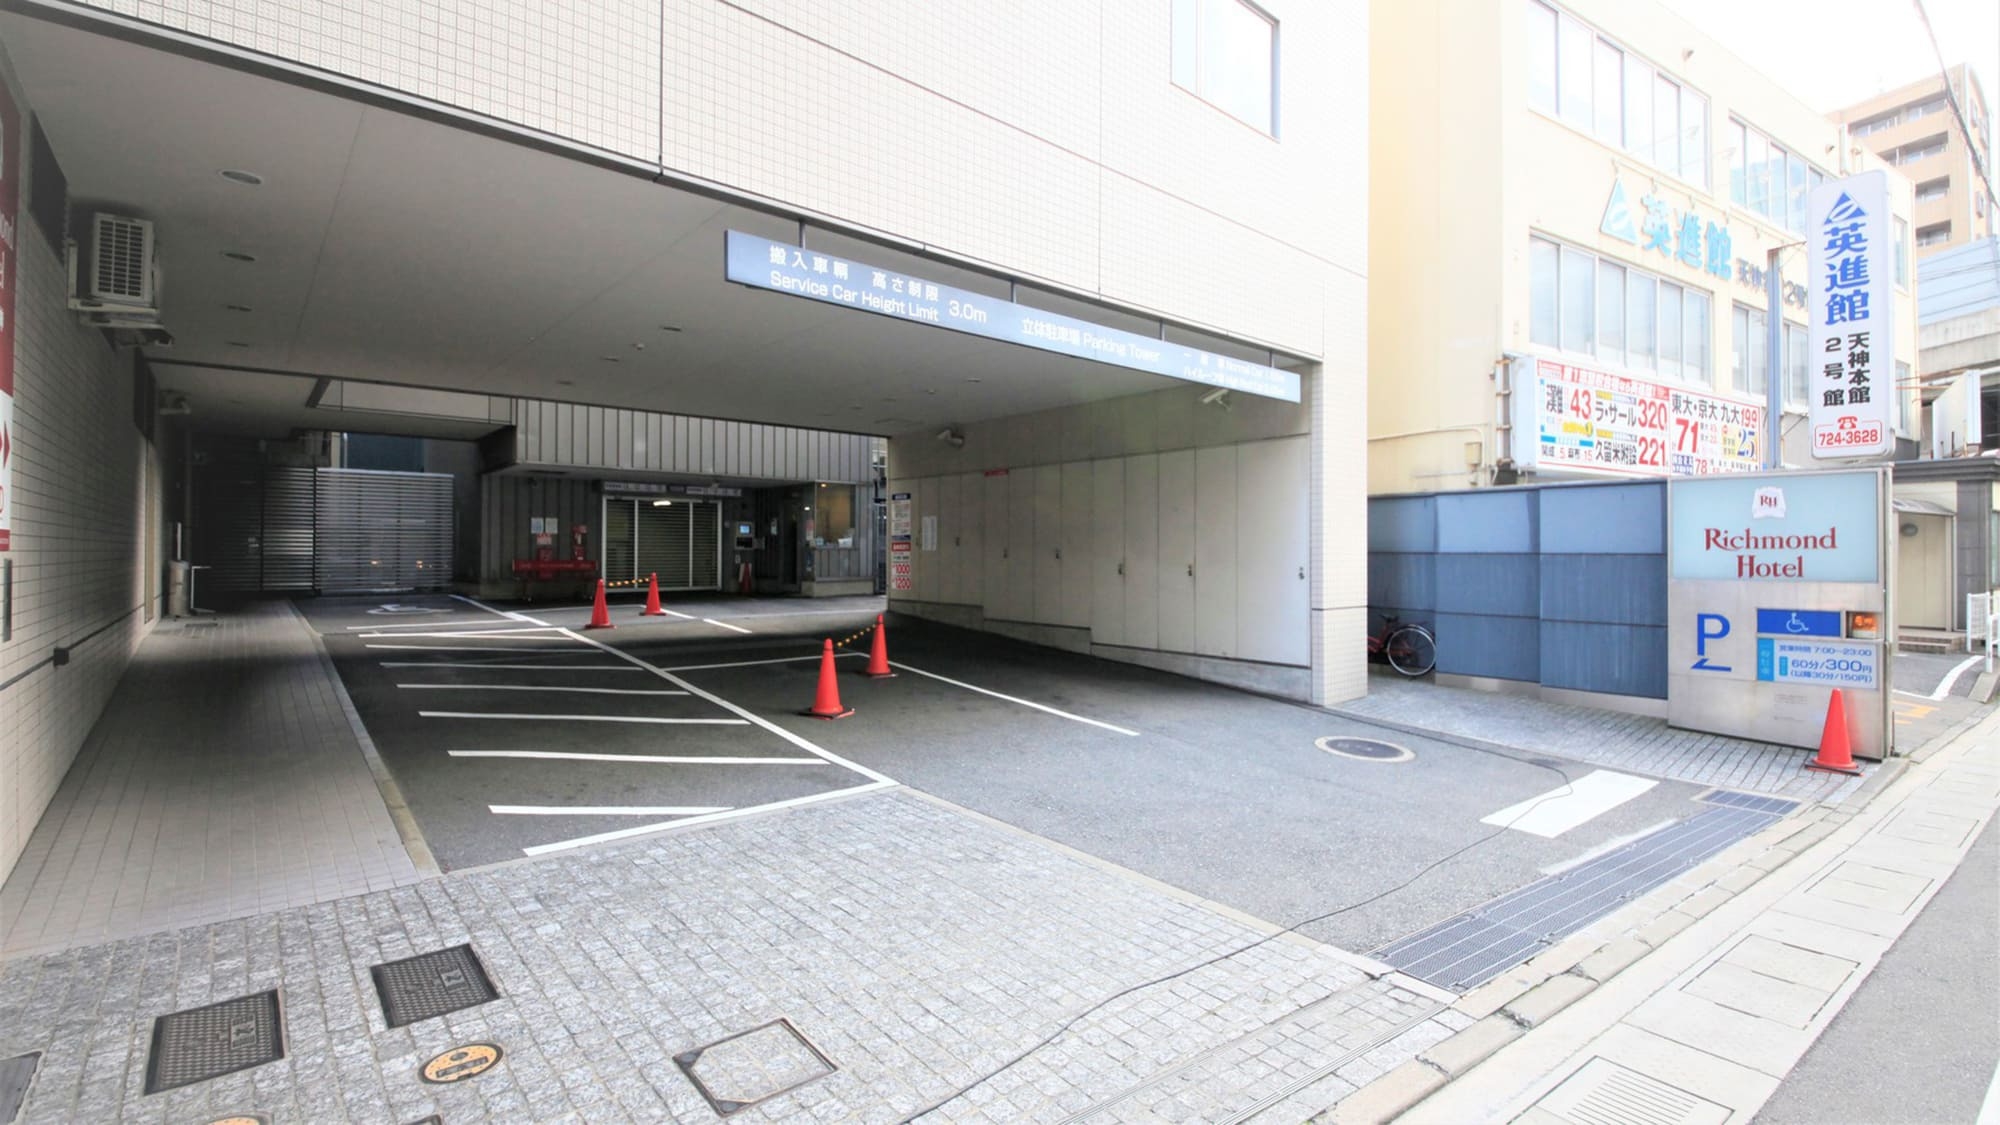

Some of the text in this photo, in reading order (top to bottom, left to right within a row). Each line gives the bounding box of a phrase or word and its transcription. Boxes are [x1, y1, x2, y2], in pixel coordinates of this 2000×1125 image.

[1641, 193, 1732, 280] 英進館
[872, 270, 939, 302] 高さ制限
[1823, 221, 1870, 326] 英進館
[770, 270, 939, 322] Service Car Height Limit
[949, 300, 987, 323] 3.0m
[1083, 332, 1127, 357] Parking
[1128, 343, 1160, 362] Tower
[1823, 336, 1844, 407] 2号館
[1848, 331, 1870, 404] 天神本館
[1570, 389, 1592, 419] 43
[1595, 398, 1667, 431] ラ・サール 320
[1672, 393, 1718, 420] 東大・京大
[1721, 403, 1757, 428] 九大 199
[1676, 418, 1698, 453] 71
[1737, 429, 1755, 458] 25
[1818, 429, 1878, 447] 724-3628
[1638, 436, 1666, 466] 221
[1695, 459, 1707, 475] 78
[1760, 495, 1778, 508] RH
[1704, 527, 1837, 551] Richmond
[1737, 555, 1804, 578] Hotel
[1697, 613, 1731, 656] P
[1791, 658, 1873, 675] 60分/300円
